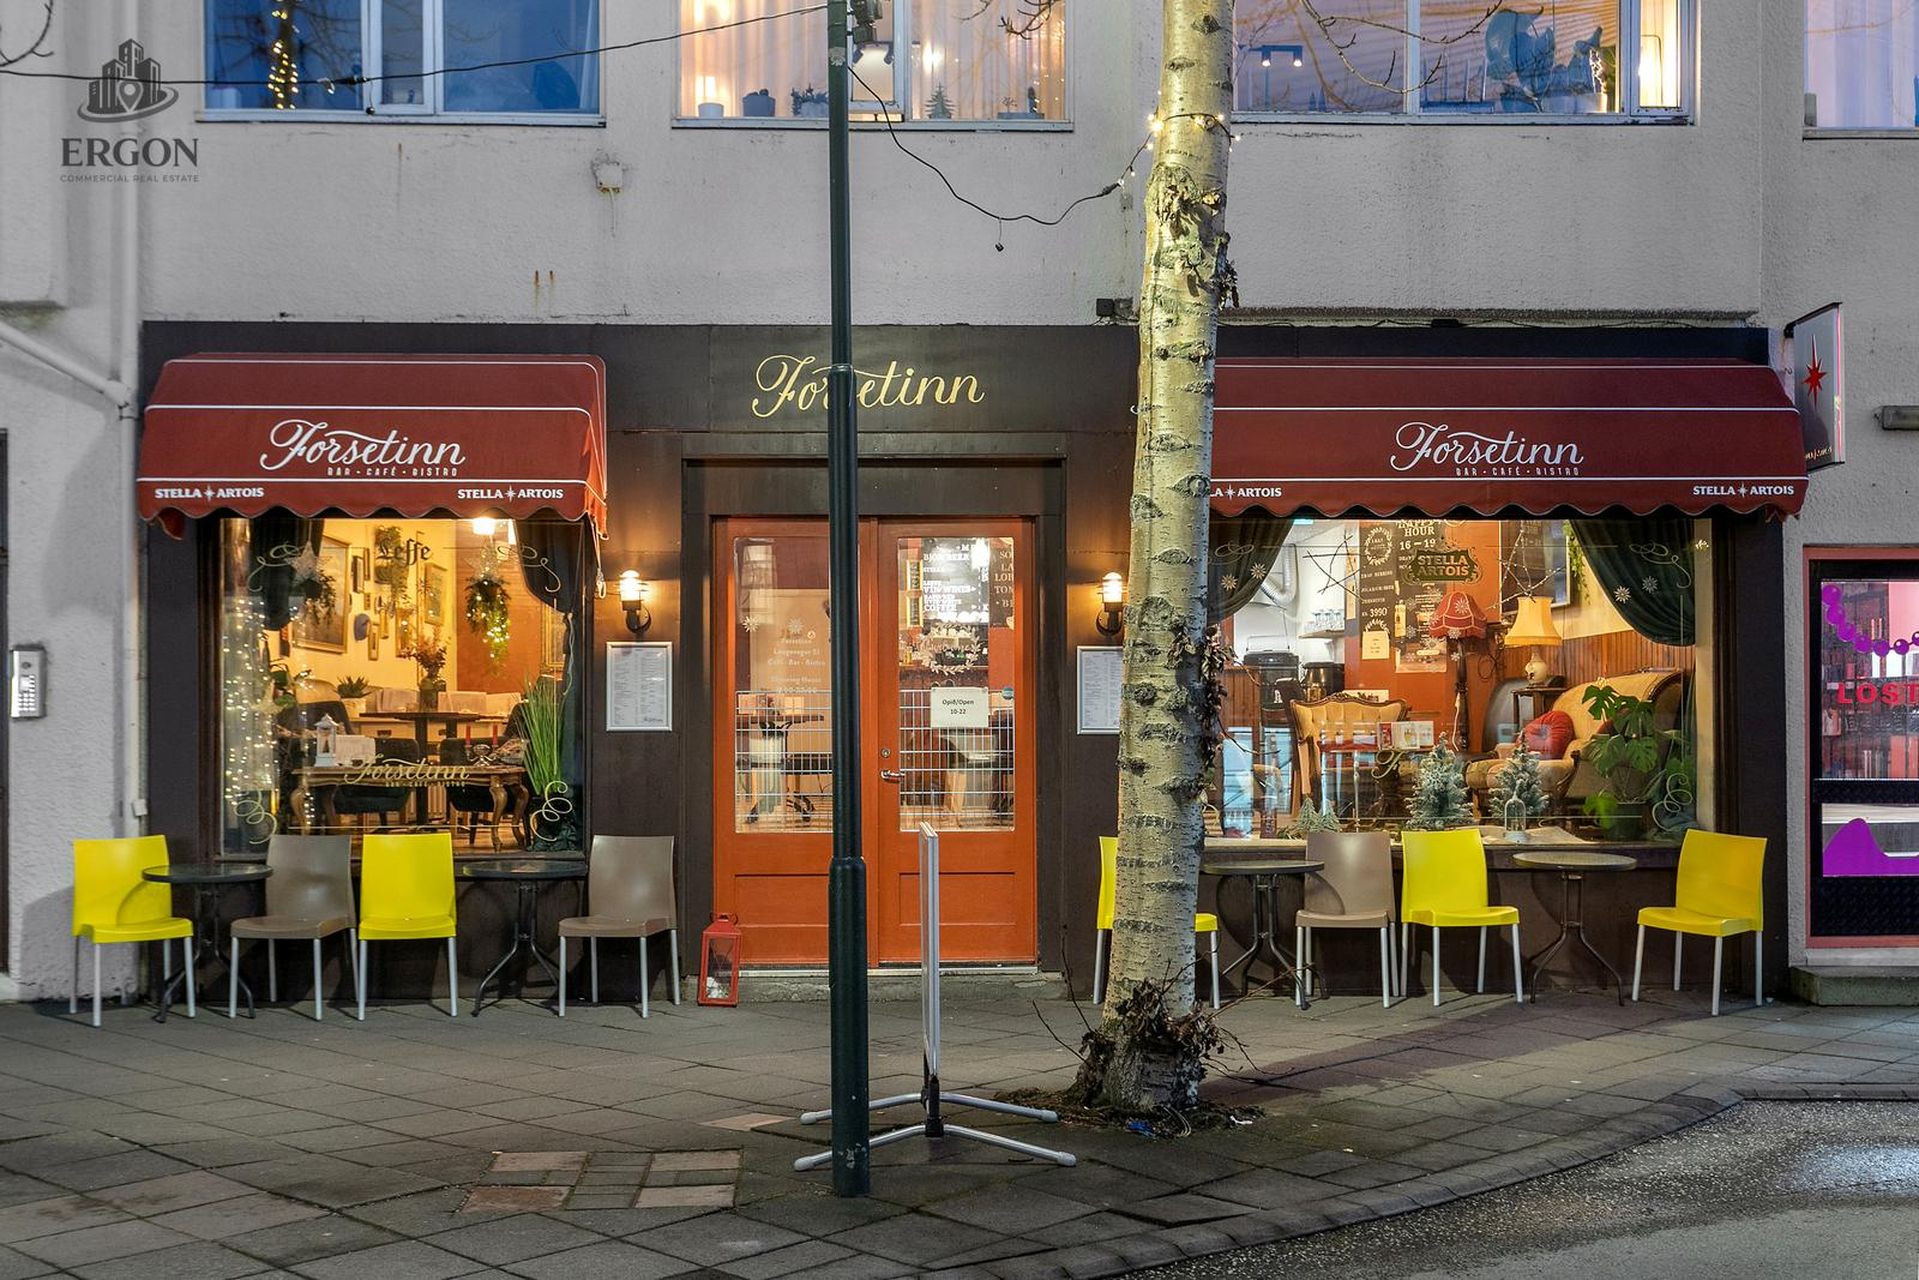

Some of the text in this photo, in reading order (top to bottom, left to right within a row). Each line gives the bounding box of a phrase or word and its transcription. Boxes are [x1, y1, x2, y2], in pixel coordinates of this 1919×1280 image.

[752, 354, 985, 418] Foetinn
[260, 419, 466, 471] Forsetinn
[1390, 421, 1584, 471] Forsetinn
[327, 466, 458, 477] BAR CAFÉ BISTRO
[1455, 465, 1580, 476] BAR CAFÉ BISTRO
[155, 487, 265, 499] STELLA ARTOIS
[457, 488, 564, 499] STELLA ARTOIS
[1237, 487, 1282, 498] ARTOIS
[1693, 485, 1794, 495] STELLA ARTOIS
[1404, 526, 1435, 537] HOUR
[1400, 540, 1411, 550] 16
[376, 538, 432, 566] Leffe
[1418, 555, 1468, 565] STELLA
[1418, 565, 1469, 576] ARTOIS
